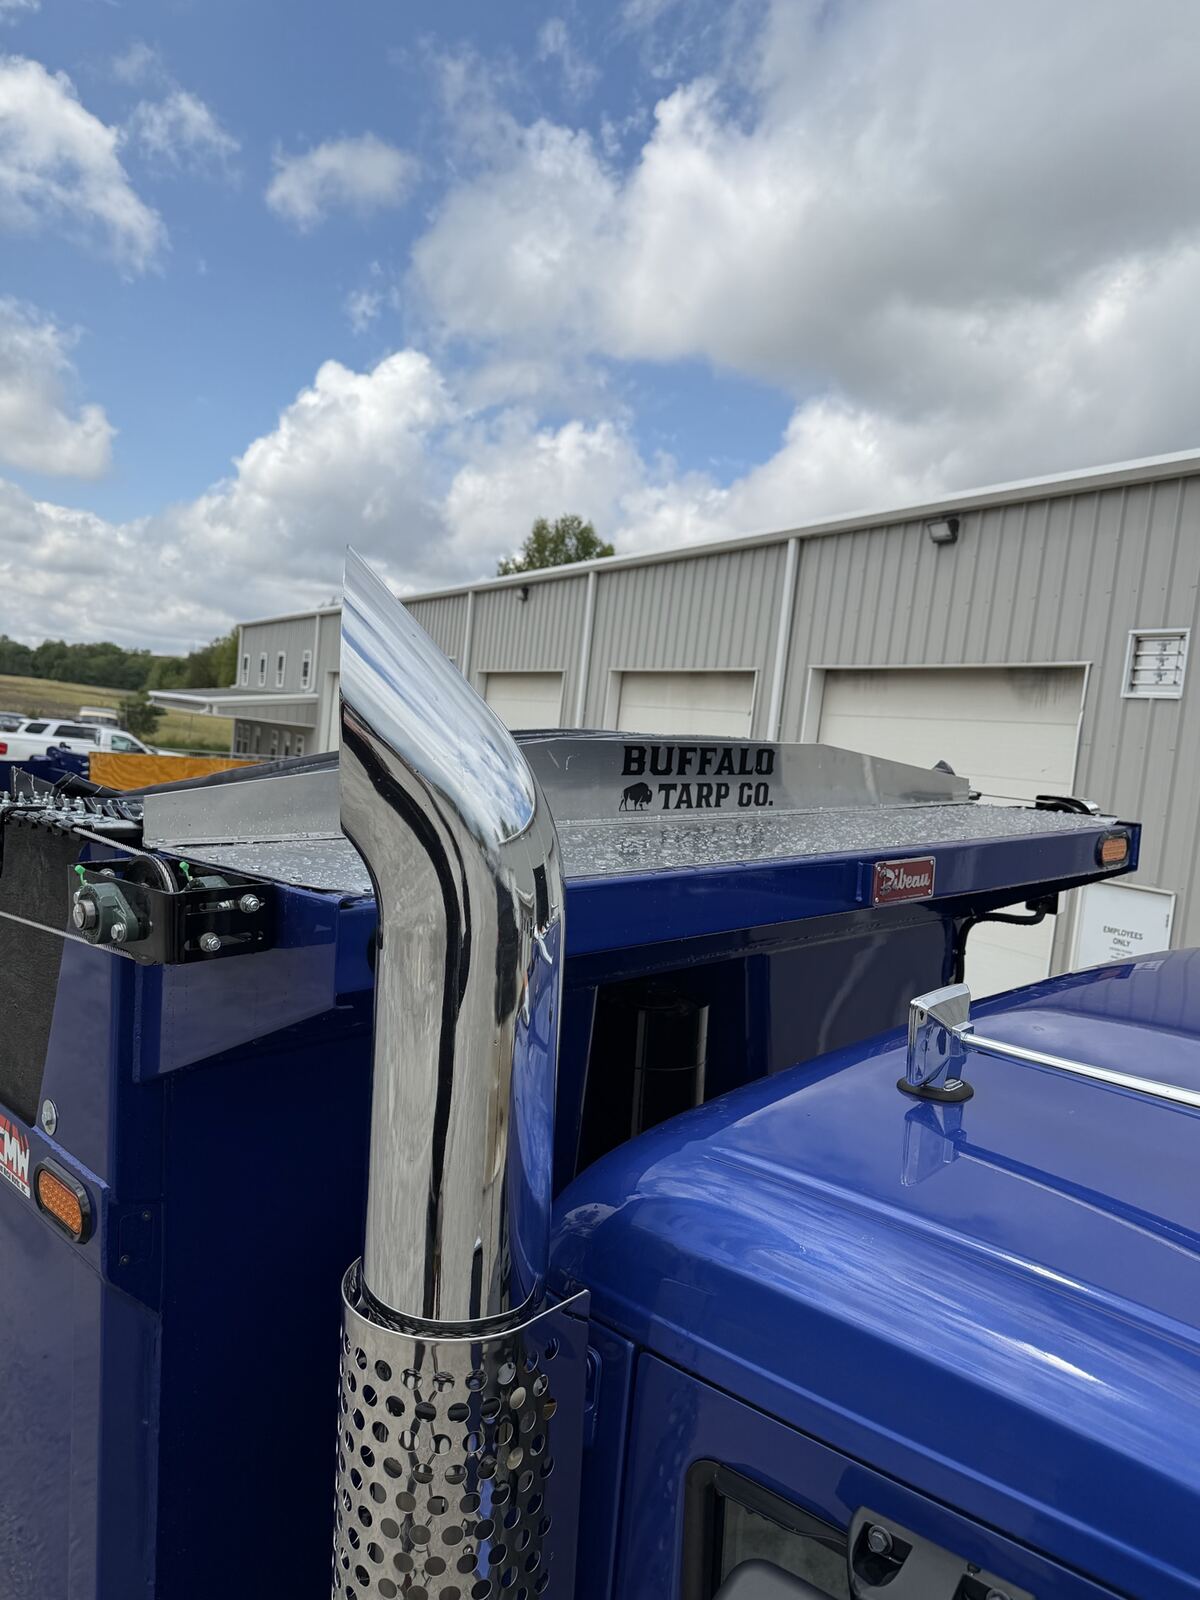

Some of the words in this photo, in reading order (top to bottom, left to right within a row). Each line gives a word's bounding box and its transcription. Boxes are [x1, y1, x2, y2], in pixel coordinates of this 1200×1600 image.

[621, 745, 775, 776] BUFFALO
[657, 782, 730, 810] TARP
[737, 782, 774, 808] CO.
[1103, 925, 1143, 940] EMPLOYEES
[1112, 937, 1131, 947] ONLY
